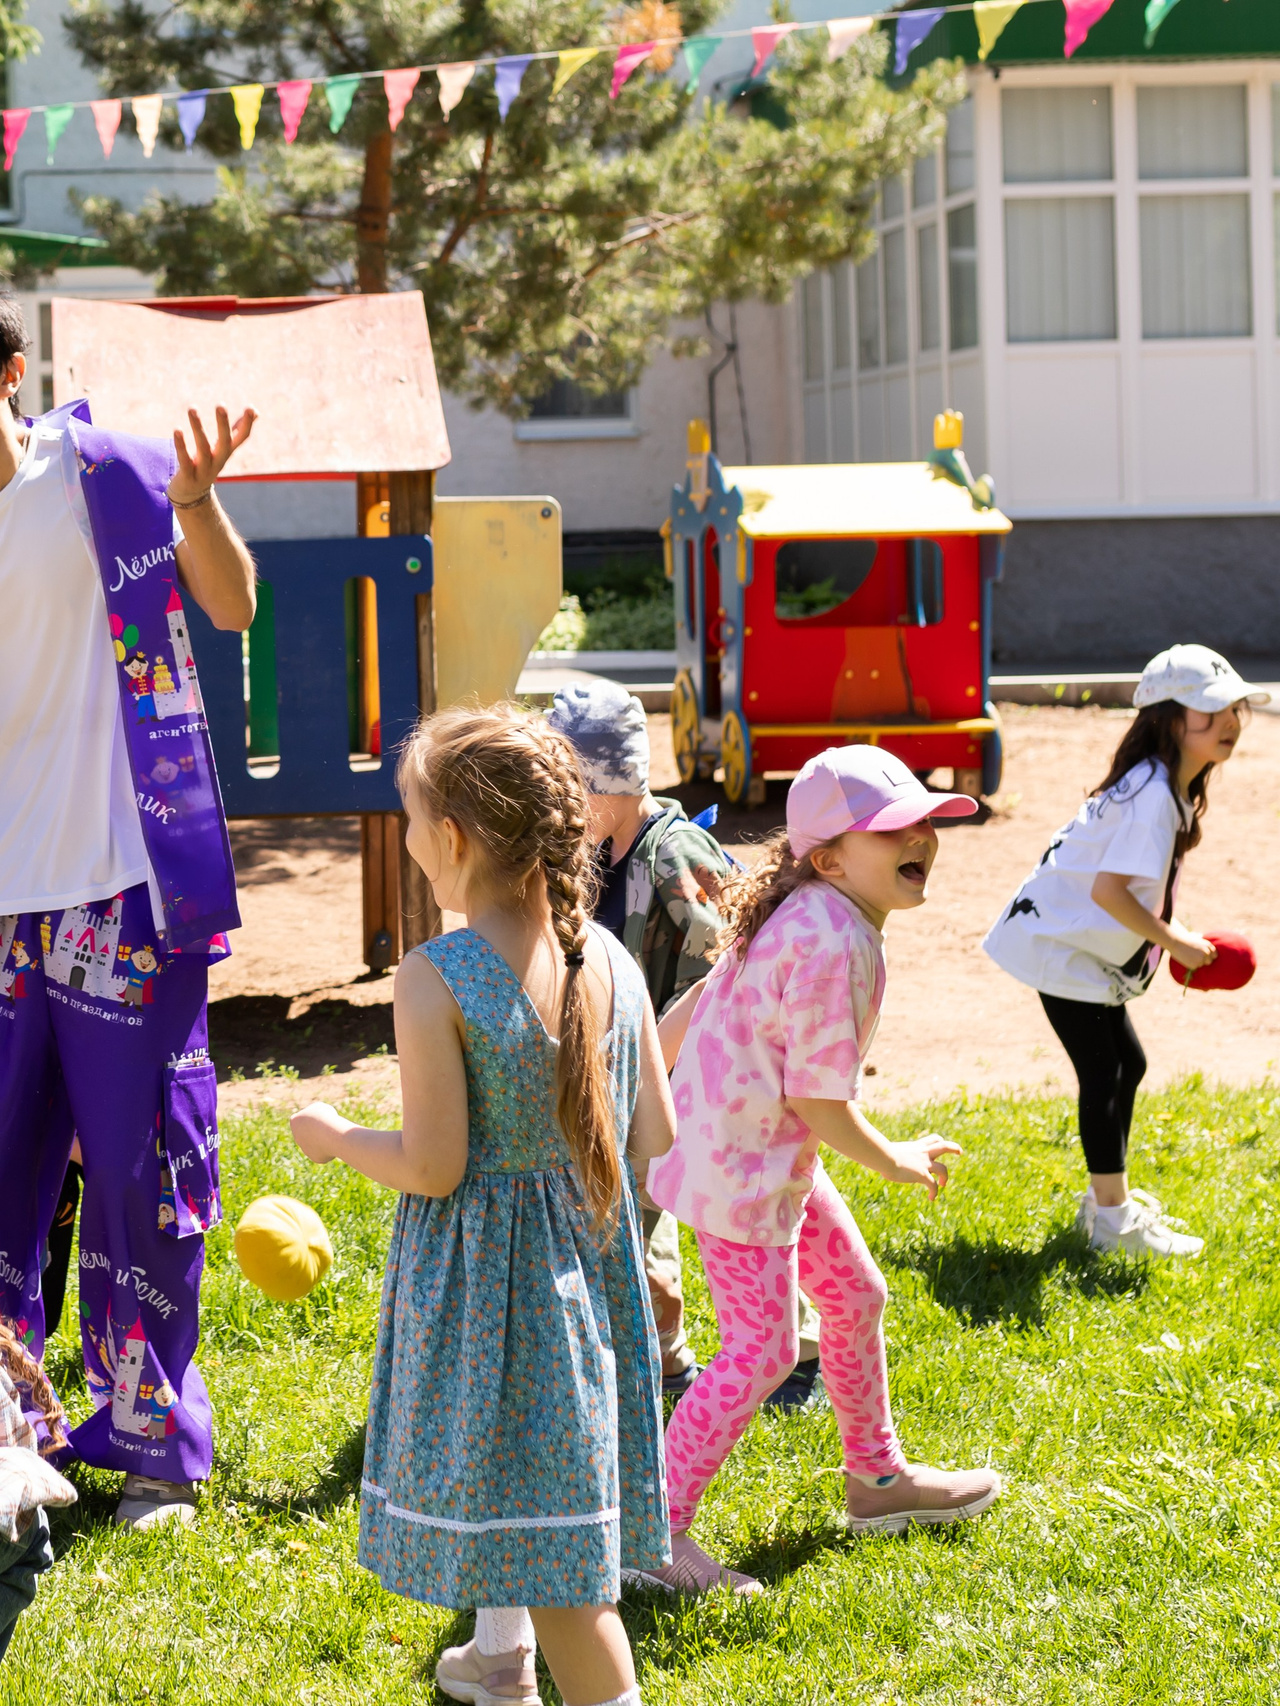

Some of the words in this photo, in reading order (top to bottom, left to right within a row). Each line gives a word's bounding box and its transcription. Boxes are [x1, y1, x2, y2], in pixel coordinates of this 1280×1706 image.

[109, 541, 176, 592] Лёлик
[69, 998, 144, 1026] праздников
[115, 1268, 130, 1287] и
[130, 1265, 179, 1320] Болик
